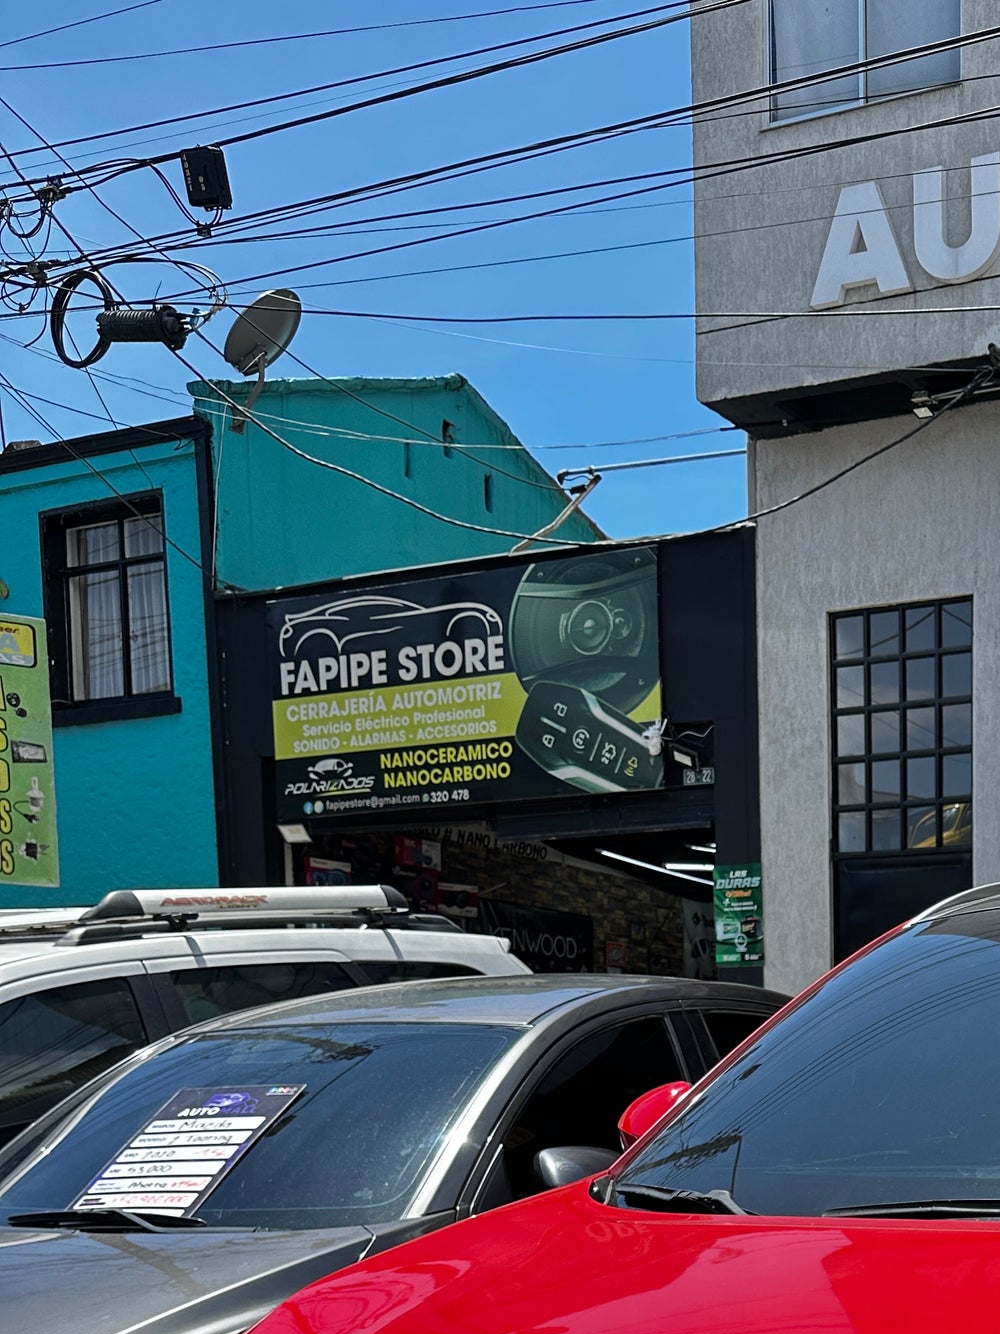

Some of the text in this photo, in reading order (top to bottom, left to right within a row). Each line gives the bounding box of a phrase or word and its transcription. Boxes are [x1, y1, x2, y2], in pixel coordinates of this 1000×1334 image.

[280, 635, 505, 696] FAPIPE STORE
[286, 681, 502, 722] CERRAJERÍA AUTOMOTRIZ
[303, 706, 485, 737] Servicio Eléctrico Profesional
[293, 738, 340, 753] SONIDO
[350, 732, 407, 748] ALARMAS
[416, 720, 497, 740] ACCESORIOS
[380, 741, 513, 769] NANOCERAMICO
[284, 776, 376, 796] POLARIZADOS
[383, 762, 511, 788] NANOCARBONO
[430, 791, 449, 804] 320
[451, 789, 470, 801] 478
[716, 877, 760, 889] DURAS
